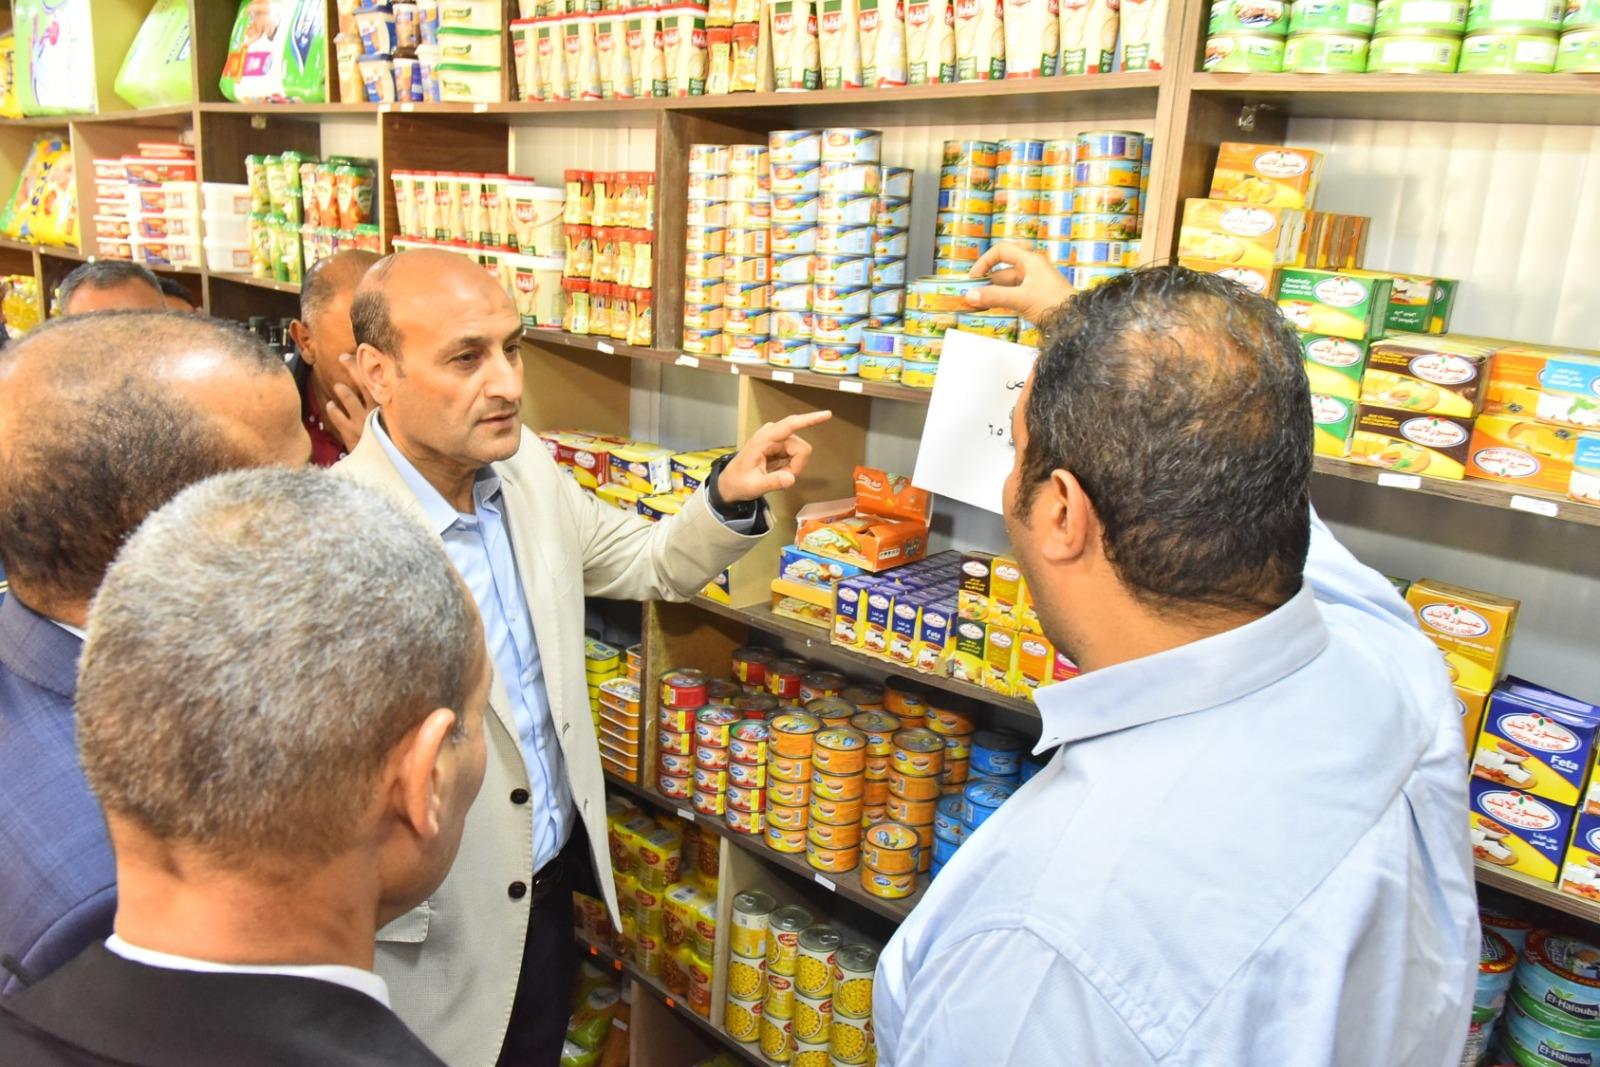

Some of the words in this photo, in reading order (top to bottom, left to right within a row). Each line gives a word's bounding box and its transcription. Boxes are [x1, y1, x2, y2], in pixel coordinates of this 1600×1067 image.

[1550, 754, 1579, 771] Feta
[1546, 993, 1598, 1017] El-Halouba
[1538, 1044, 1591, 1067] El-Halouba
